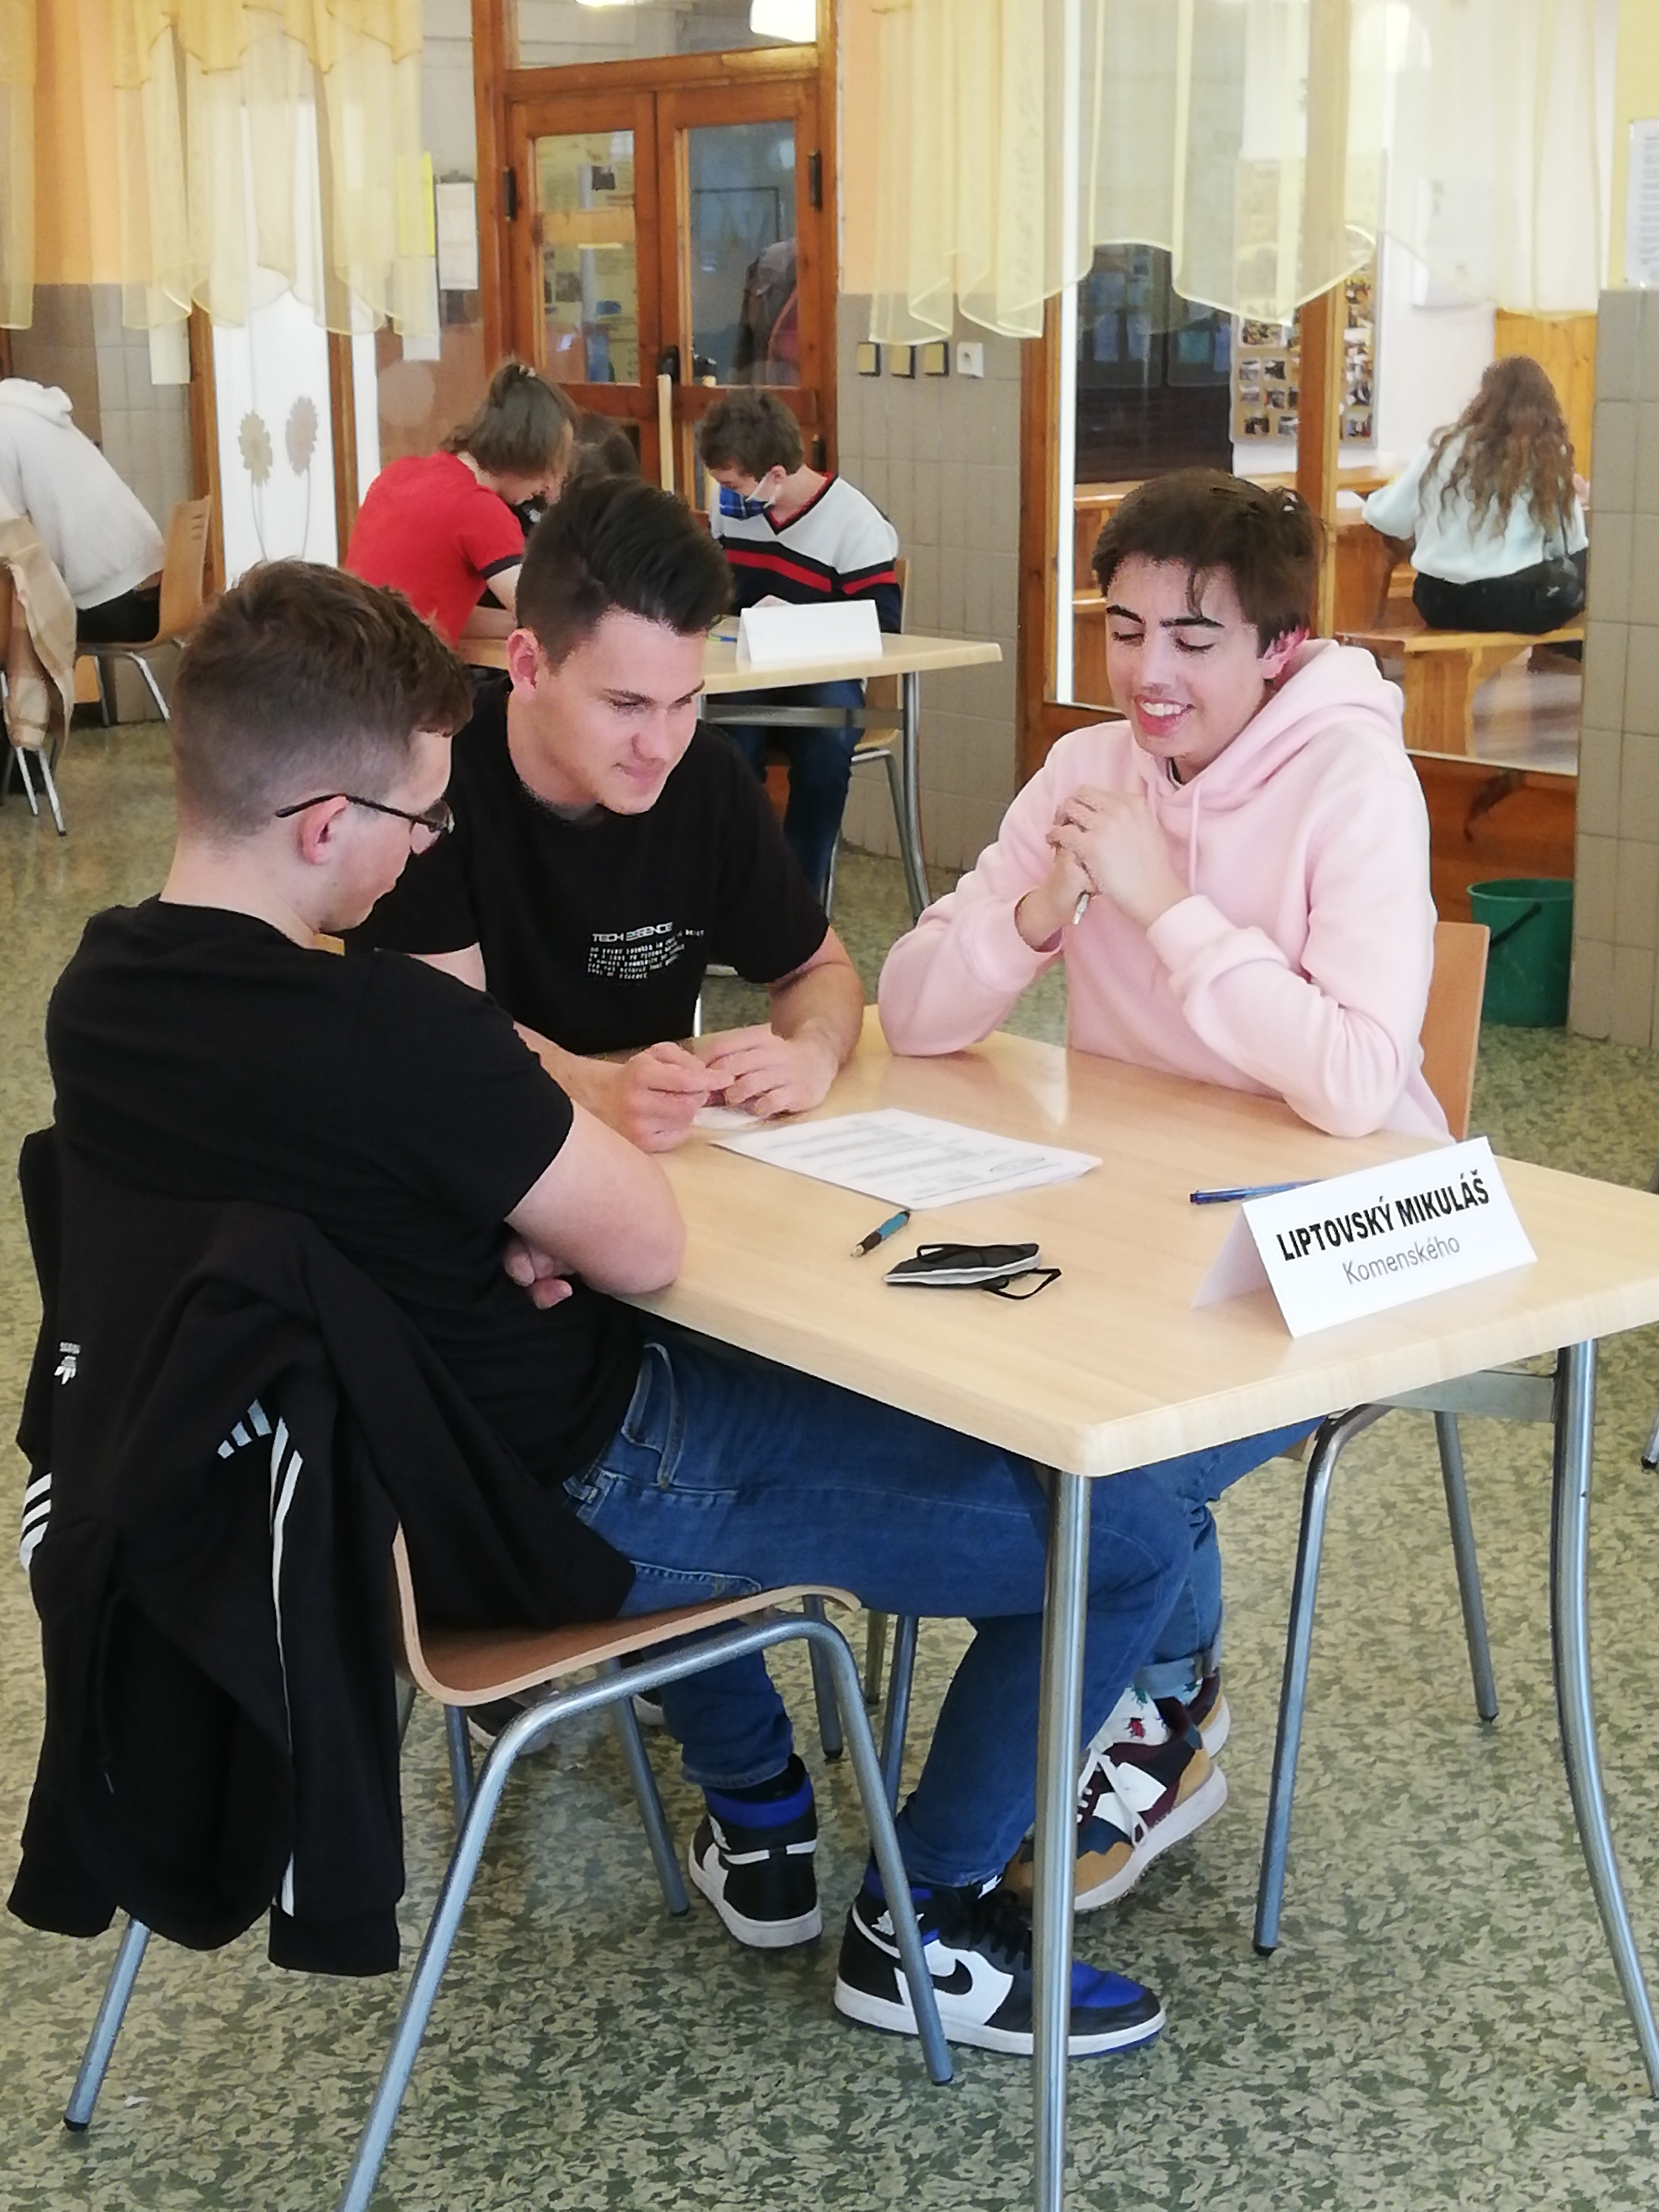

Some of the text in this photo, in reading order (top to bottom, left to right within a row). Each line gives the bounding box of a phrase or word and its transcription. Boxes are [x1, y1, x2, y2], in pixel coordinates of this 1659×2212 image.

[592, 933, 624, 942] TECH
[1276, 1169, 1490, 1261] LIPTOVSKÝ MIKULÁŠ
[1343, 1235, 1460, 1285] Komenského
